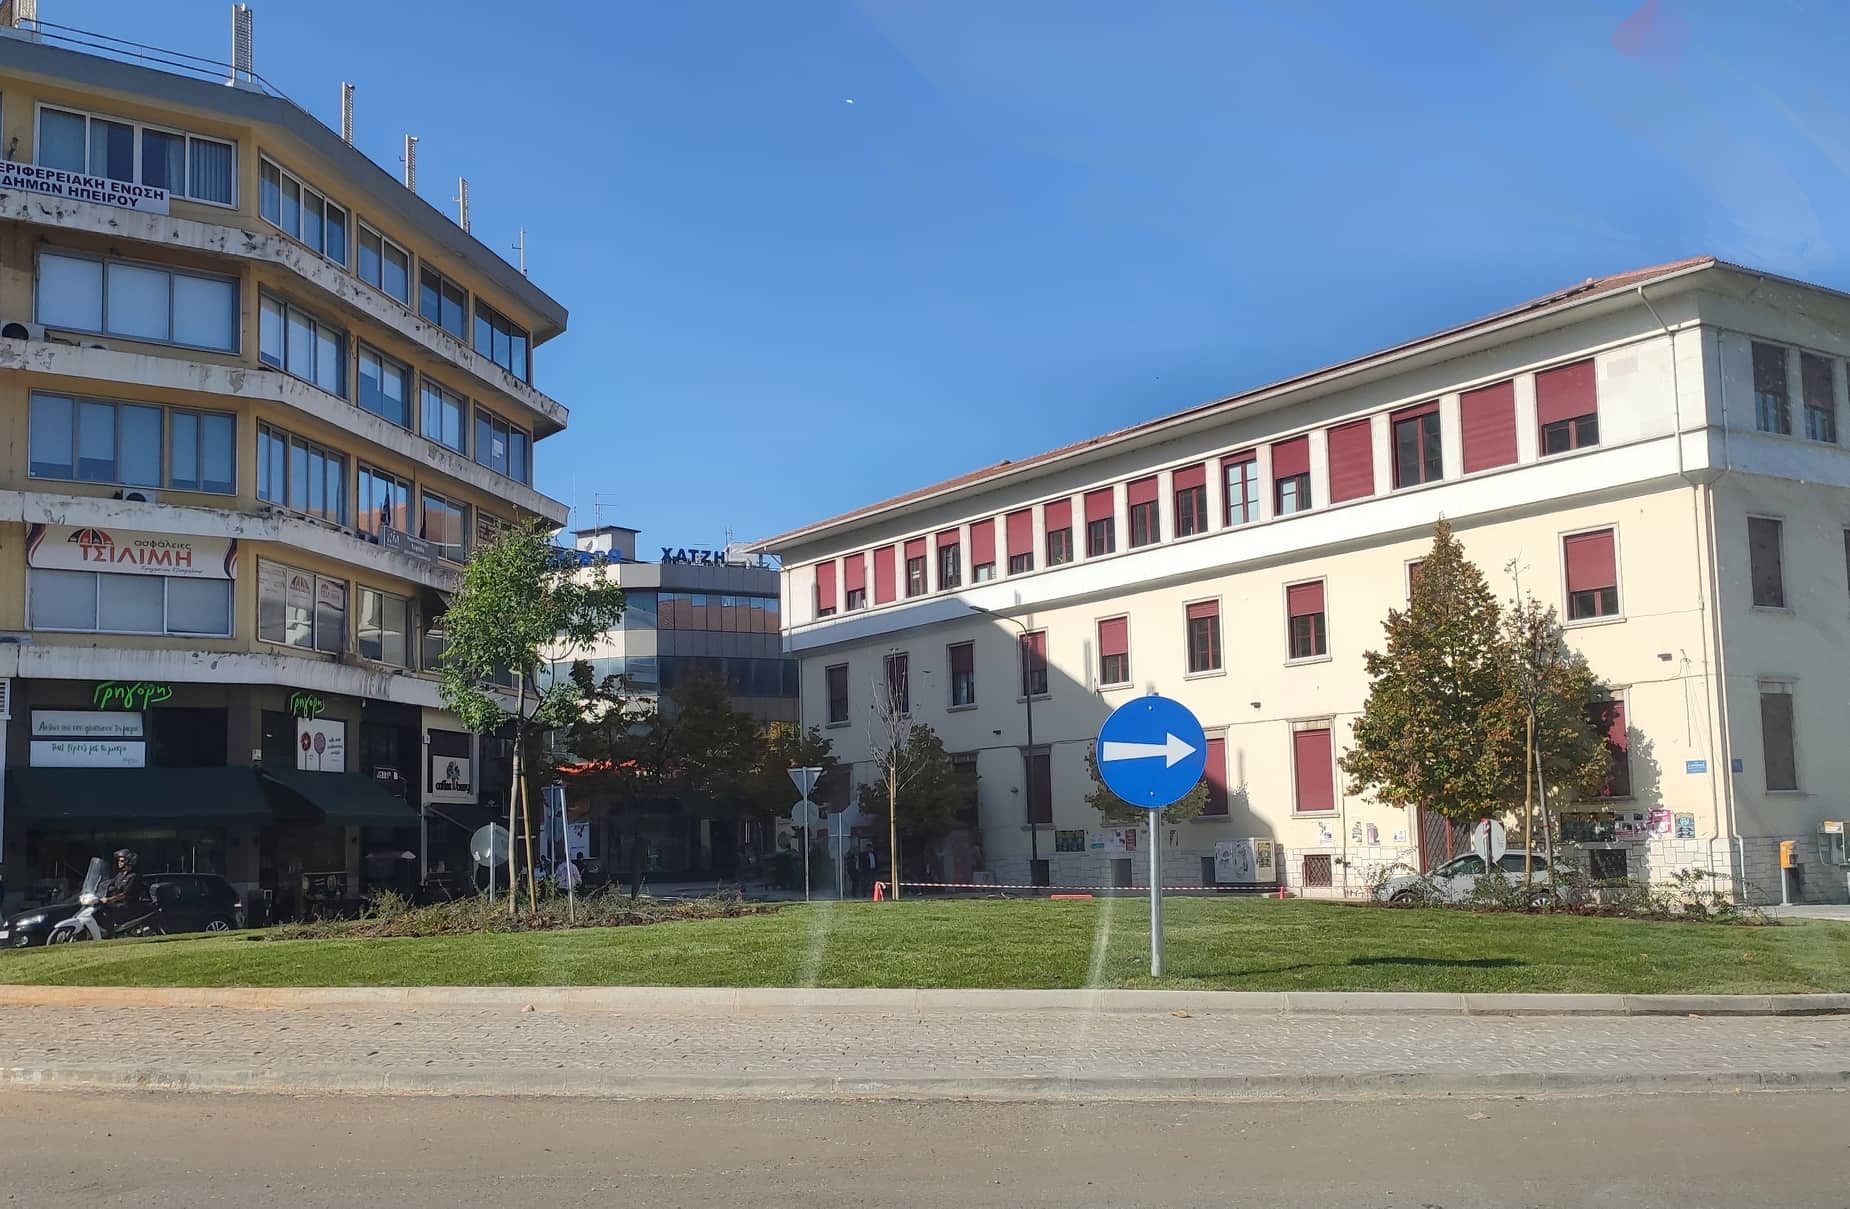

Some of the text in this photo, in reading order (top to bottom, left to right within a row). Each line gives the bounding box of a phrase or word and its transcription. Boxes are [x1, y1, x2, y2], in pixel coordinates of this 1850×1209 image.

[2, 175, 139, 208] ΔΗΜΩΝ ΗΠΕΙΡΟΥ
[111, 182, 164, 201] ΕΝΩΣΗ
[79, 544, 192, 568] ΤΣΙΛΙΜΗ
[661, 547, 726, 566] ΧΑΤΖΗ
